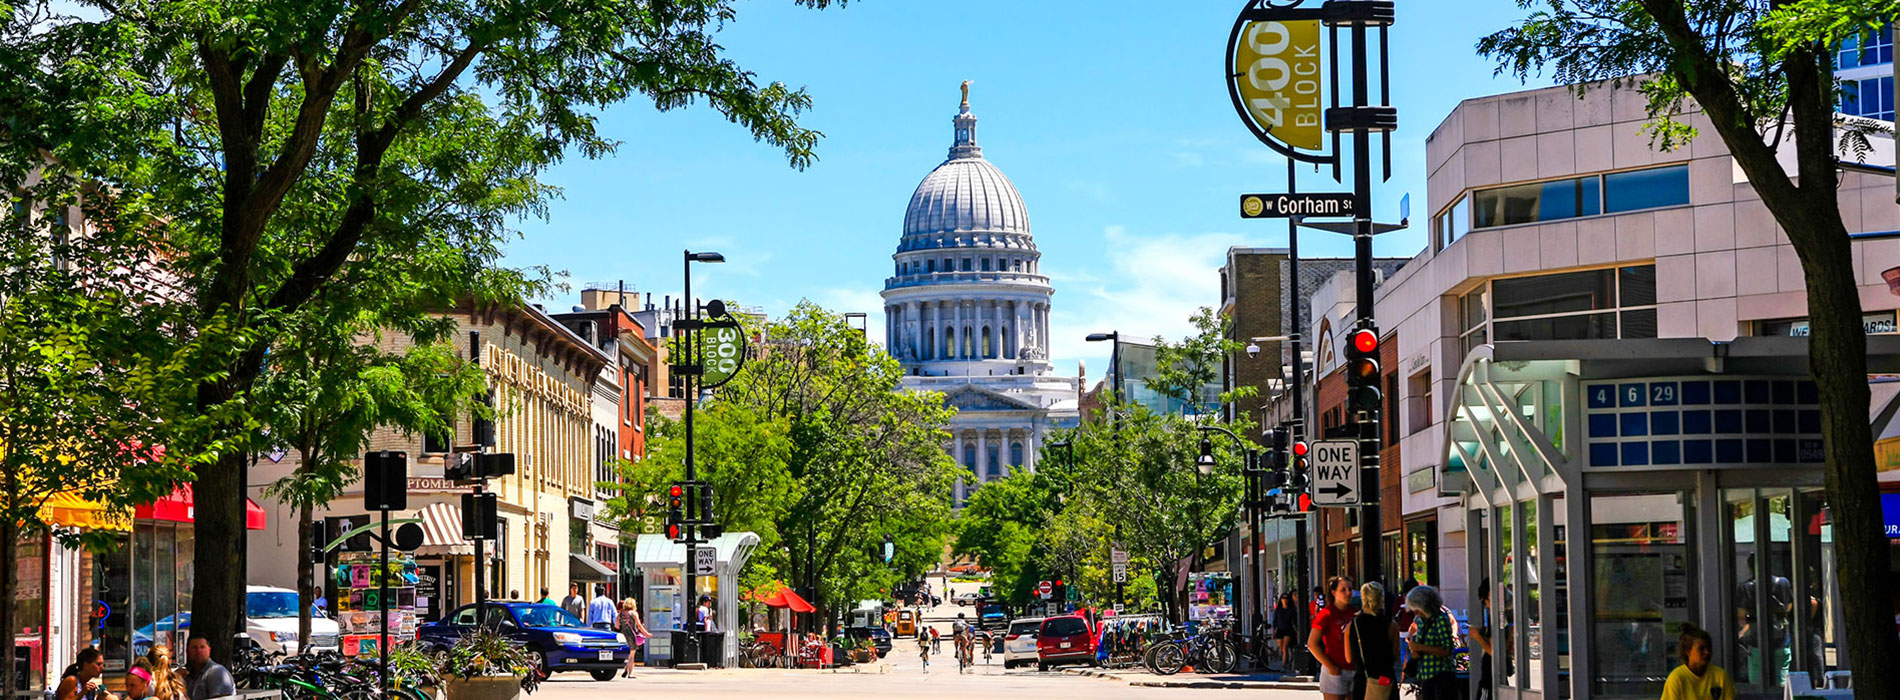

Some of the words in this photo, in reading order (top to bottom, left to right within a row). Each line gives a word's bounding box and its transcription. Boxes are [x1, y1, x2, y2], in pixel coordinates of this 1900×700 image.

[1248, 21, 1290, 127] 400
[1294, 44, 1318, 127] BLOCK
[1266, 200, 1273, 210] W
[1278, 196, 1339, 214] Gorham
[1343, 199, 1352, 209] St
[706, 337, 717, 373] BLOCK
[717, 327, 737, 373] 300
[1597, 389, 1606, 403] 4
[1628, 387, 1637, 402] 6
[1654, 386, 1673, 401] 29
[1318, 447, 1352, 462] ONE
[1317, 465, 1352, 480] WAY
[1115, 572, 1125, 581] 15
